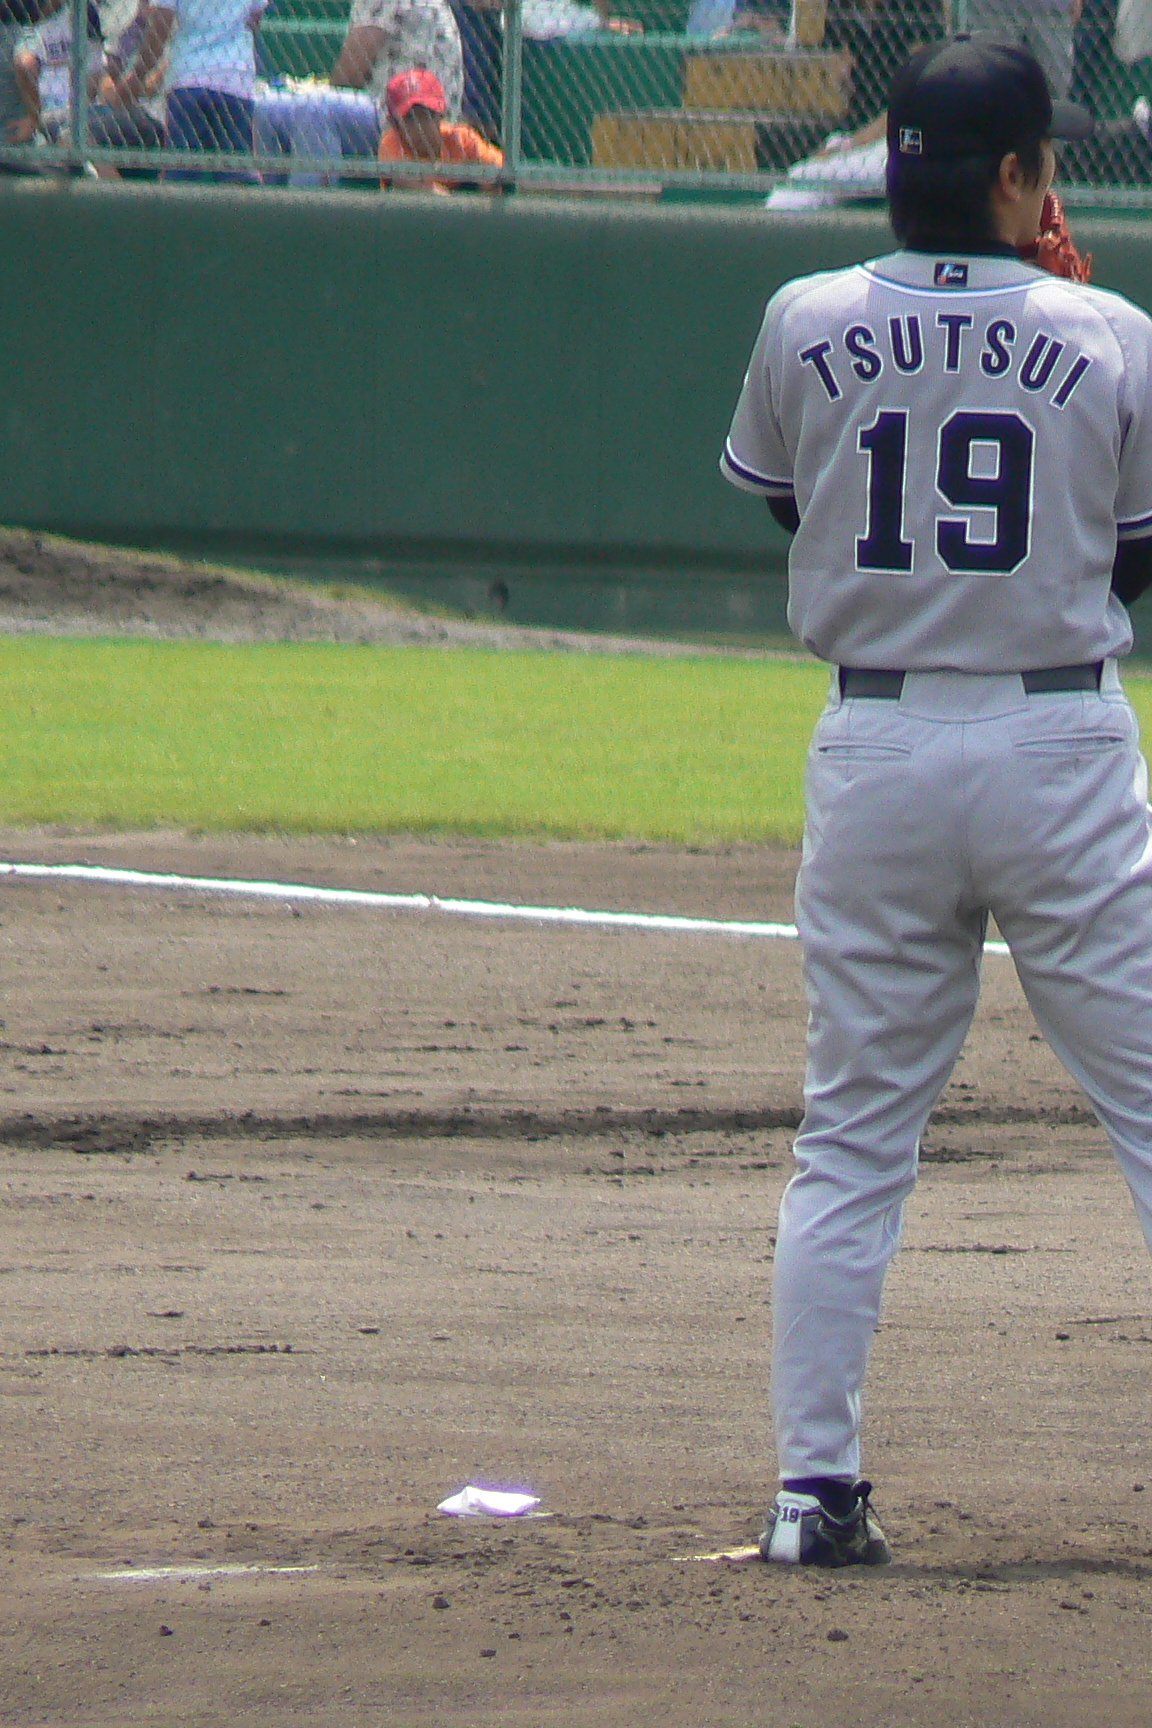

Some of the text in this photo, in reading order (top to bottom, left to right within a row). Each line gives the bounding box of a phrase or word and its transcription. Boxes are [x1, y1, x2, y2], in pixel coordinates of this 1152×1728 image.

[799, 310, 1093, 410] TSUTSUI
[855, 406, 1036, 576] 19
[780, 1505, 800, 1523] 19
